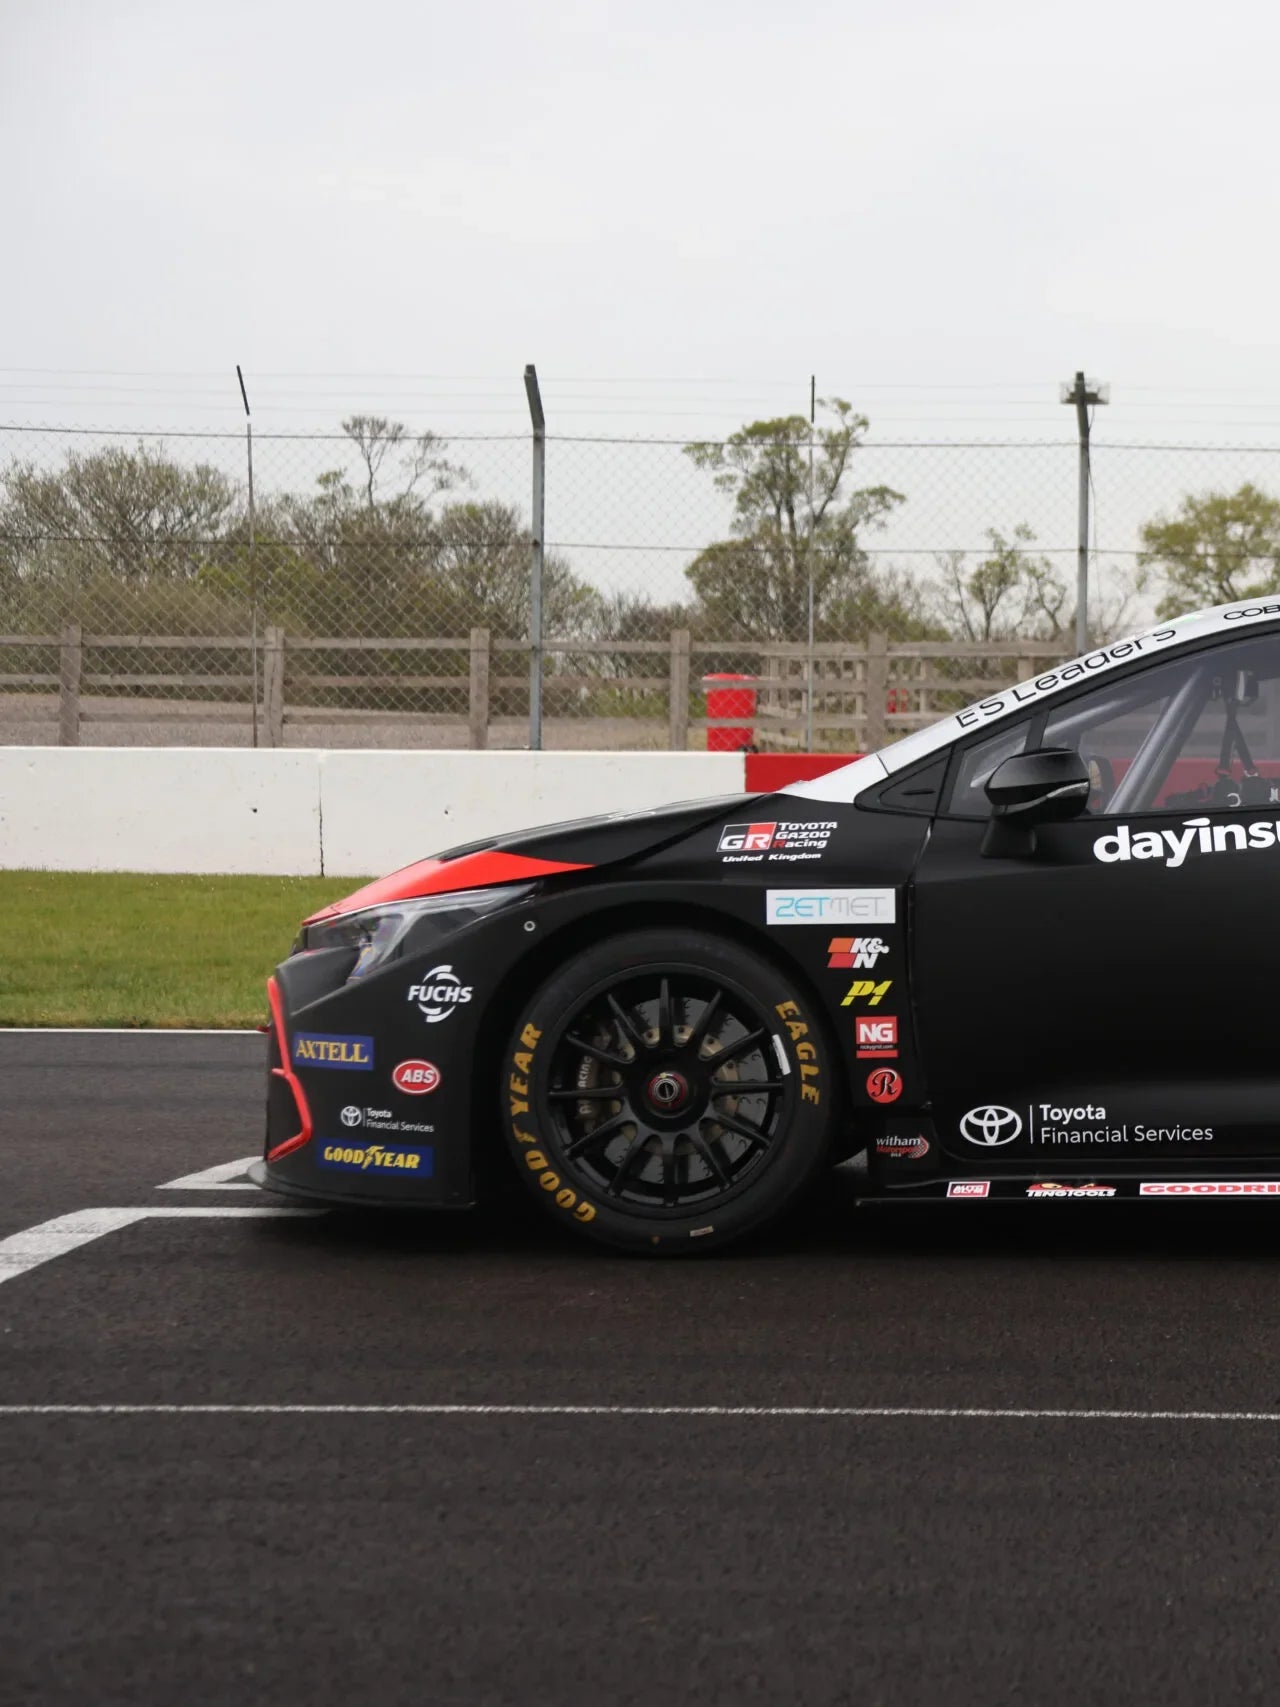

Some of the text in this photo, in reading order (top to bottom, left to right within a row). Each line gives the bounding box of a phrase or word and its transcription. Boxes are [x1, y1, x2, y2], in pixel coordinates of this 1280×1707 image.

[956, 698, 1005, 728] ES
[778, 822, 837, 831] TOYOTA
[720, 834, 770, 850] GR
[772, 839, 827, 849] Racing
[775, 831, 831, 840] GAZOO
[722, 853, 821, 863] United Kingdom
[408, 985, 473, 1003] FUCHS
[840, 981, 893, 1006] P1
[859, 1023, 893, 1042] NG
[296, 1039, 369, 1064] AXTELL
[774, 1000, 820, 1105] EAGLE
[401, 1069, 435, 1084] ABS
[367, 1107, 392, 1119] Toyota
[1040, 1104, 1106, 1124] Toyota
[366, 1119, 434, 1133] Financial Services
[1041, 1125, 1214, 1144] Financial Services
[876, 1136, 921, 1146] witham
[323, 1146, 420, 1169] GOODYEAR
